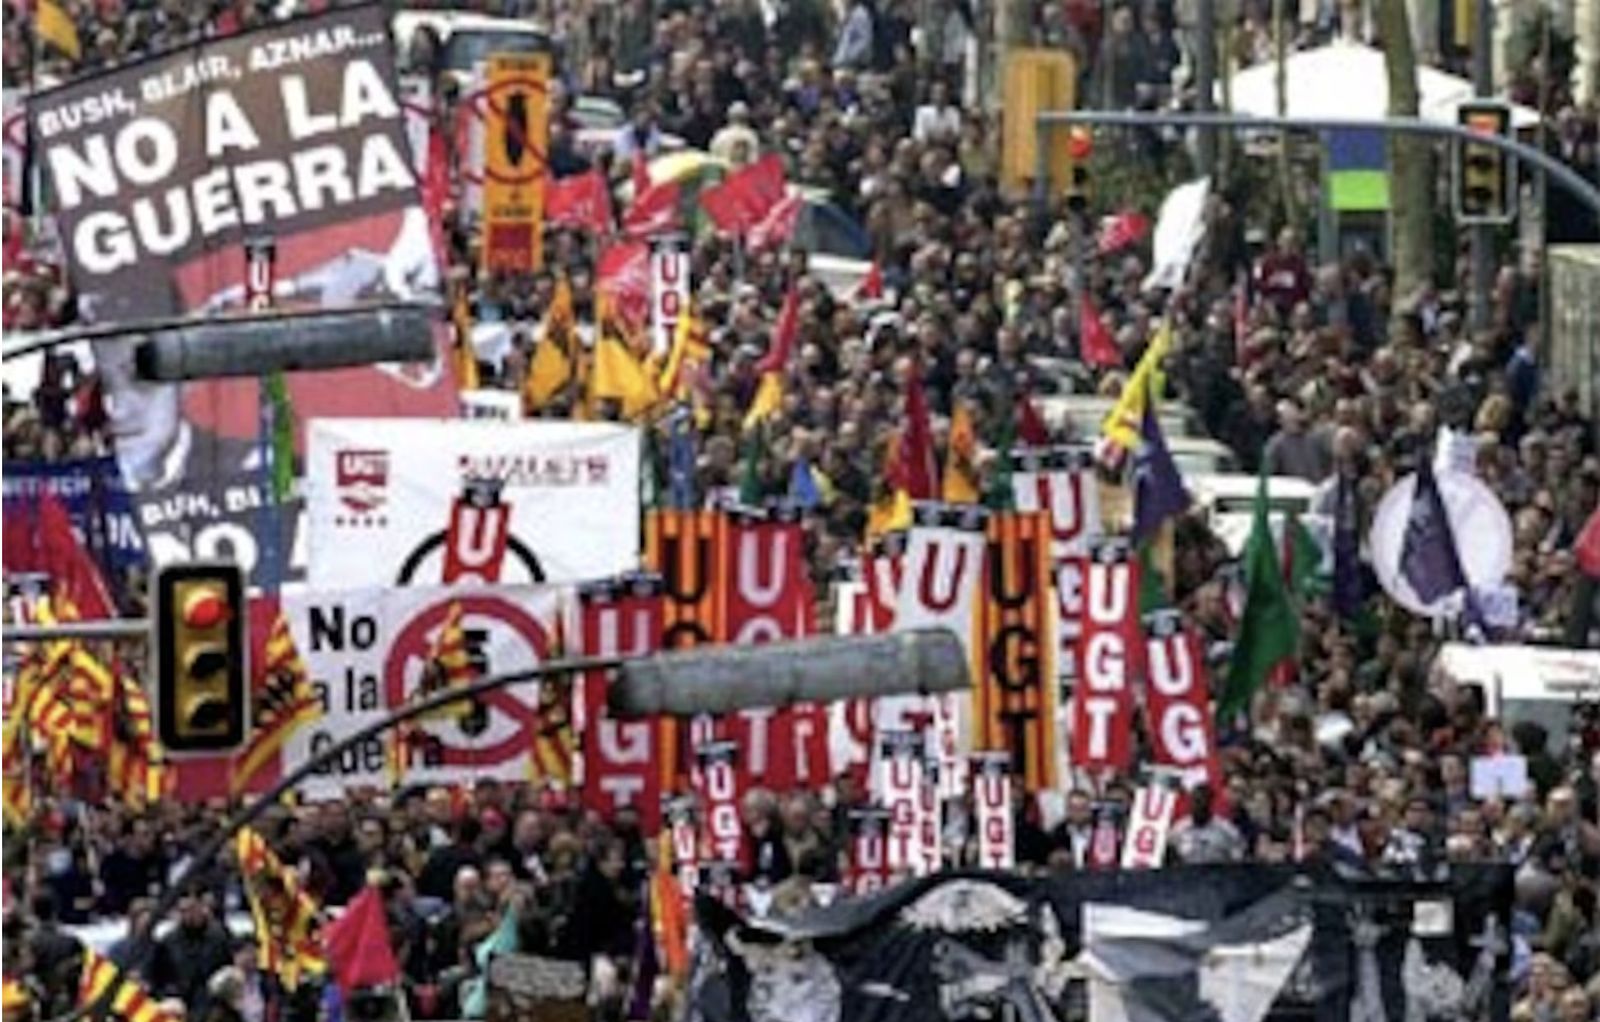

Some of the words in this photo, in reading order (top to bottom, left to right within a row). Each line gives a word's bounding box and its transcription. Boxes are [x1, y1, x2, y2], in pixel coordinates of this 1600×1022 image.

[37, 87, 136, 137] BUSH,
[140, 55, 243, 101] BLAIR,
[47, 117, 178, 208] NO
[205, 90, 260, 157] A
[280, 59, 401, 140] LA
[73, 133, 416, 273] GUERRA
[309, 605, 377, 652] No
[345, 664, 378, 713] la
[987, 537, 1039, 775] UGT
[1083, 562, 1130, 760] UGT
